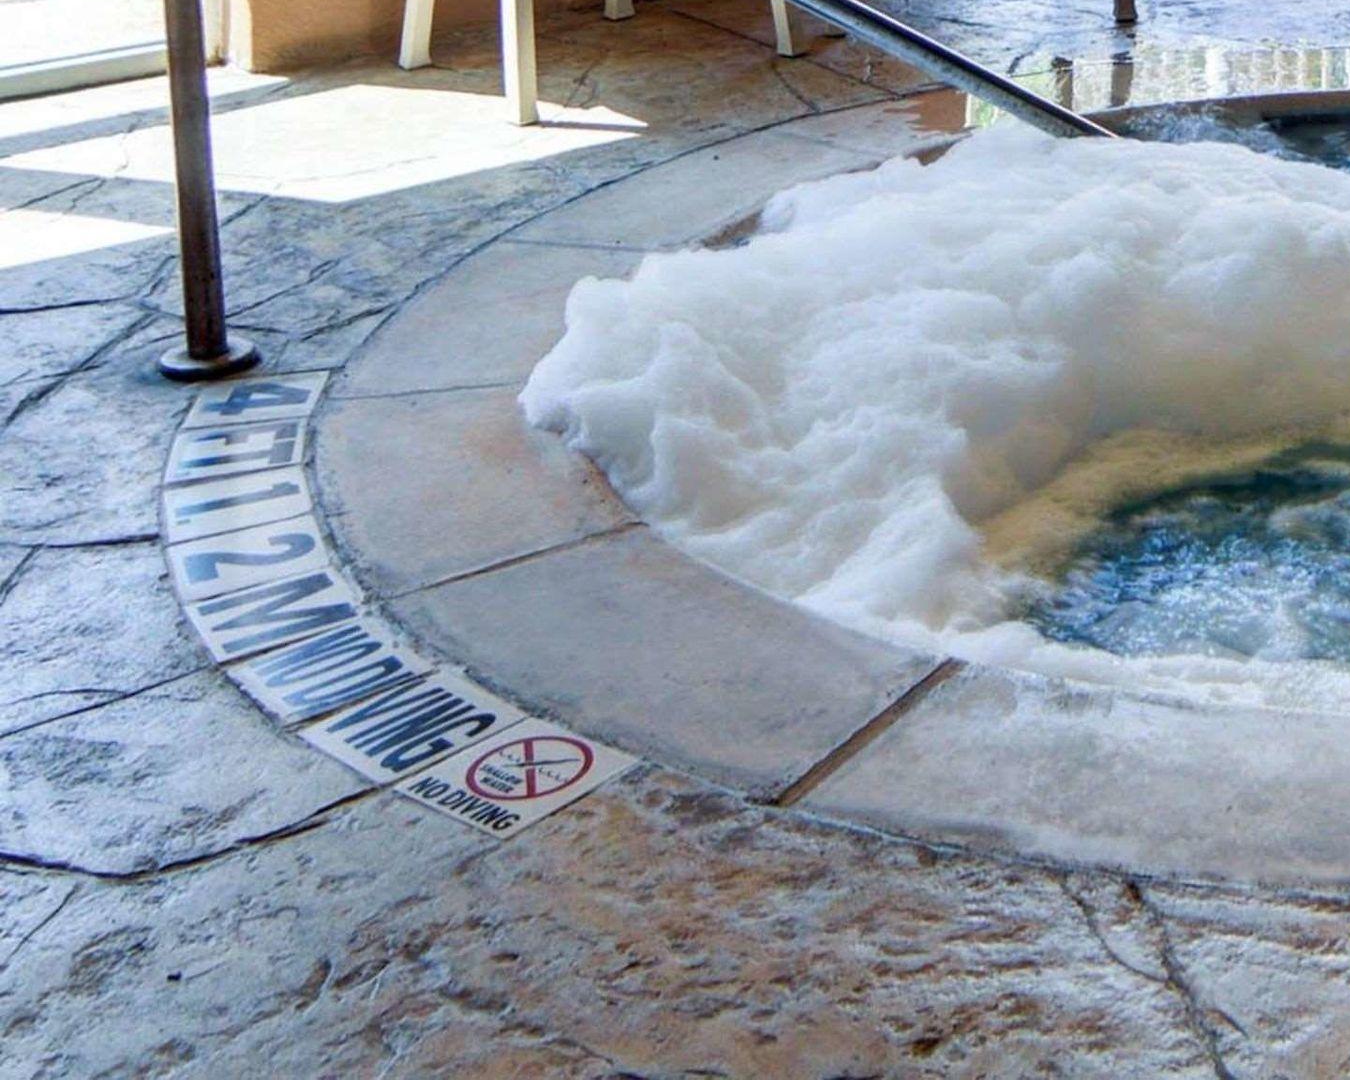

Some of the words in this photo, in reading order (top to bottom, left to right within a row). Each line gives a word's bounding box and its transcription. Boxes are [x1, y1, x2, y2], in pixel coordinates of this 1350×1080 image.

[197, 572, 359, 654] M
[252, 625, 383, 689] NO
[282, 655, 496, 773] DIVING
[408, 775, 451, 800] NO
[436, 789, 521, 831] DIVING
